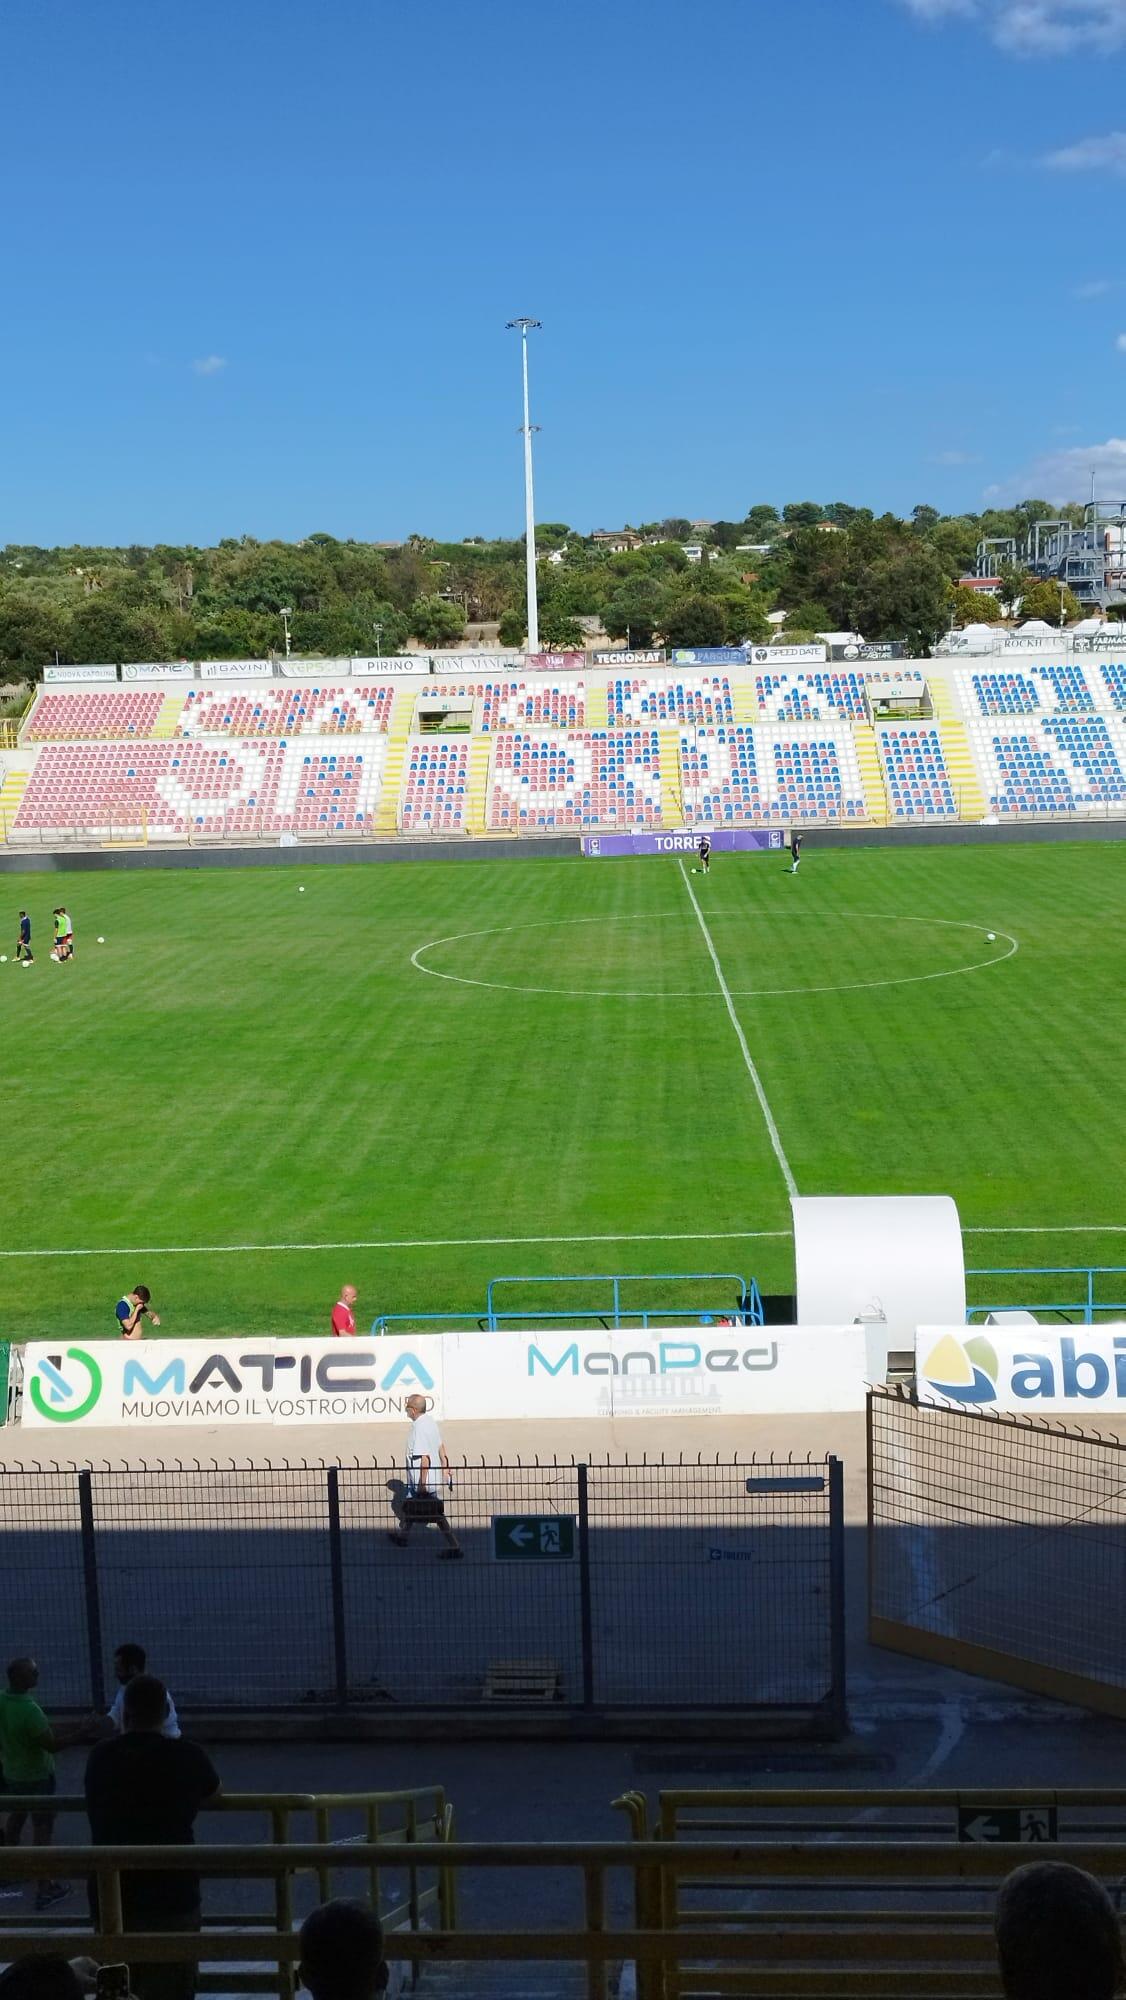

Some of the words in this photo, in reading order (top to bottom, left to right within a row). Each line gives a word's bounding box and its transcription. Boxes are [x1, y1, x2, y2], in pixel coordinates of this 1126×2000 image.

[770, 648, 798, 656] SPEED
[799, 647, 821, 655] DATE
[597, 652, 661, 664] TECNOMAT
[139, 665, 192, 673] MATICA
[219, 664, 267, 672] GAVINI
[527, 1341, 779, 1376] ManPed
[123, 1352, 435, 1396] MATICA
[121, 1399, 240, 1418] MUOVIAMO
[245, 1398, 261, 1416] IL
[268, 1397, 347, 1417] VOSTRO
[671, 1406, 721, 1415] MANAGEMENT
